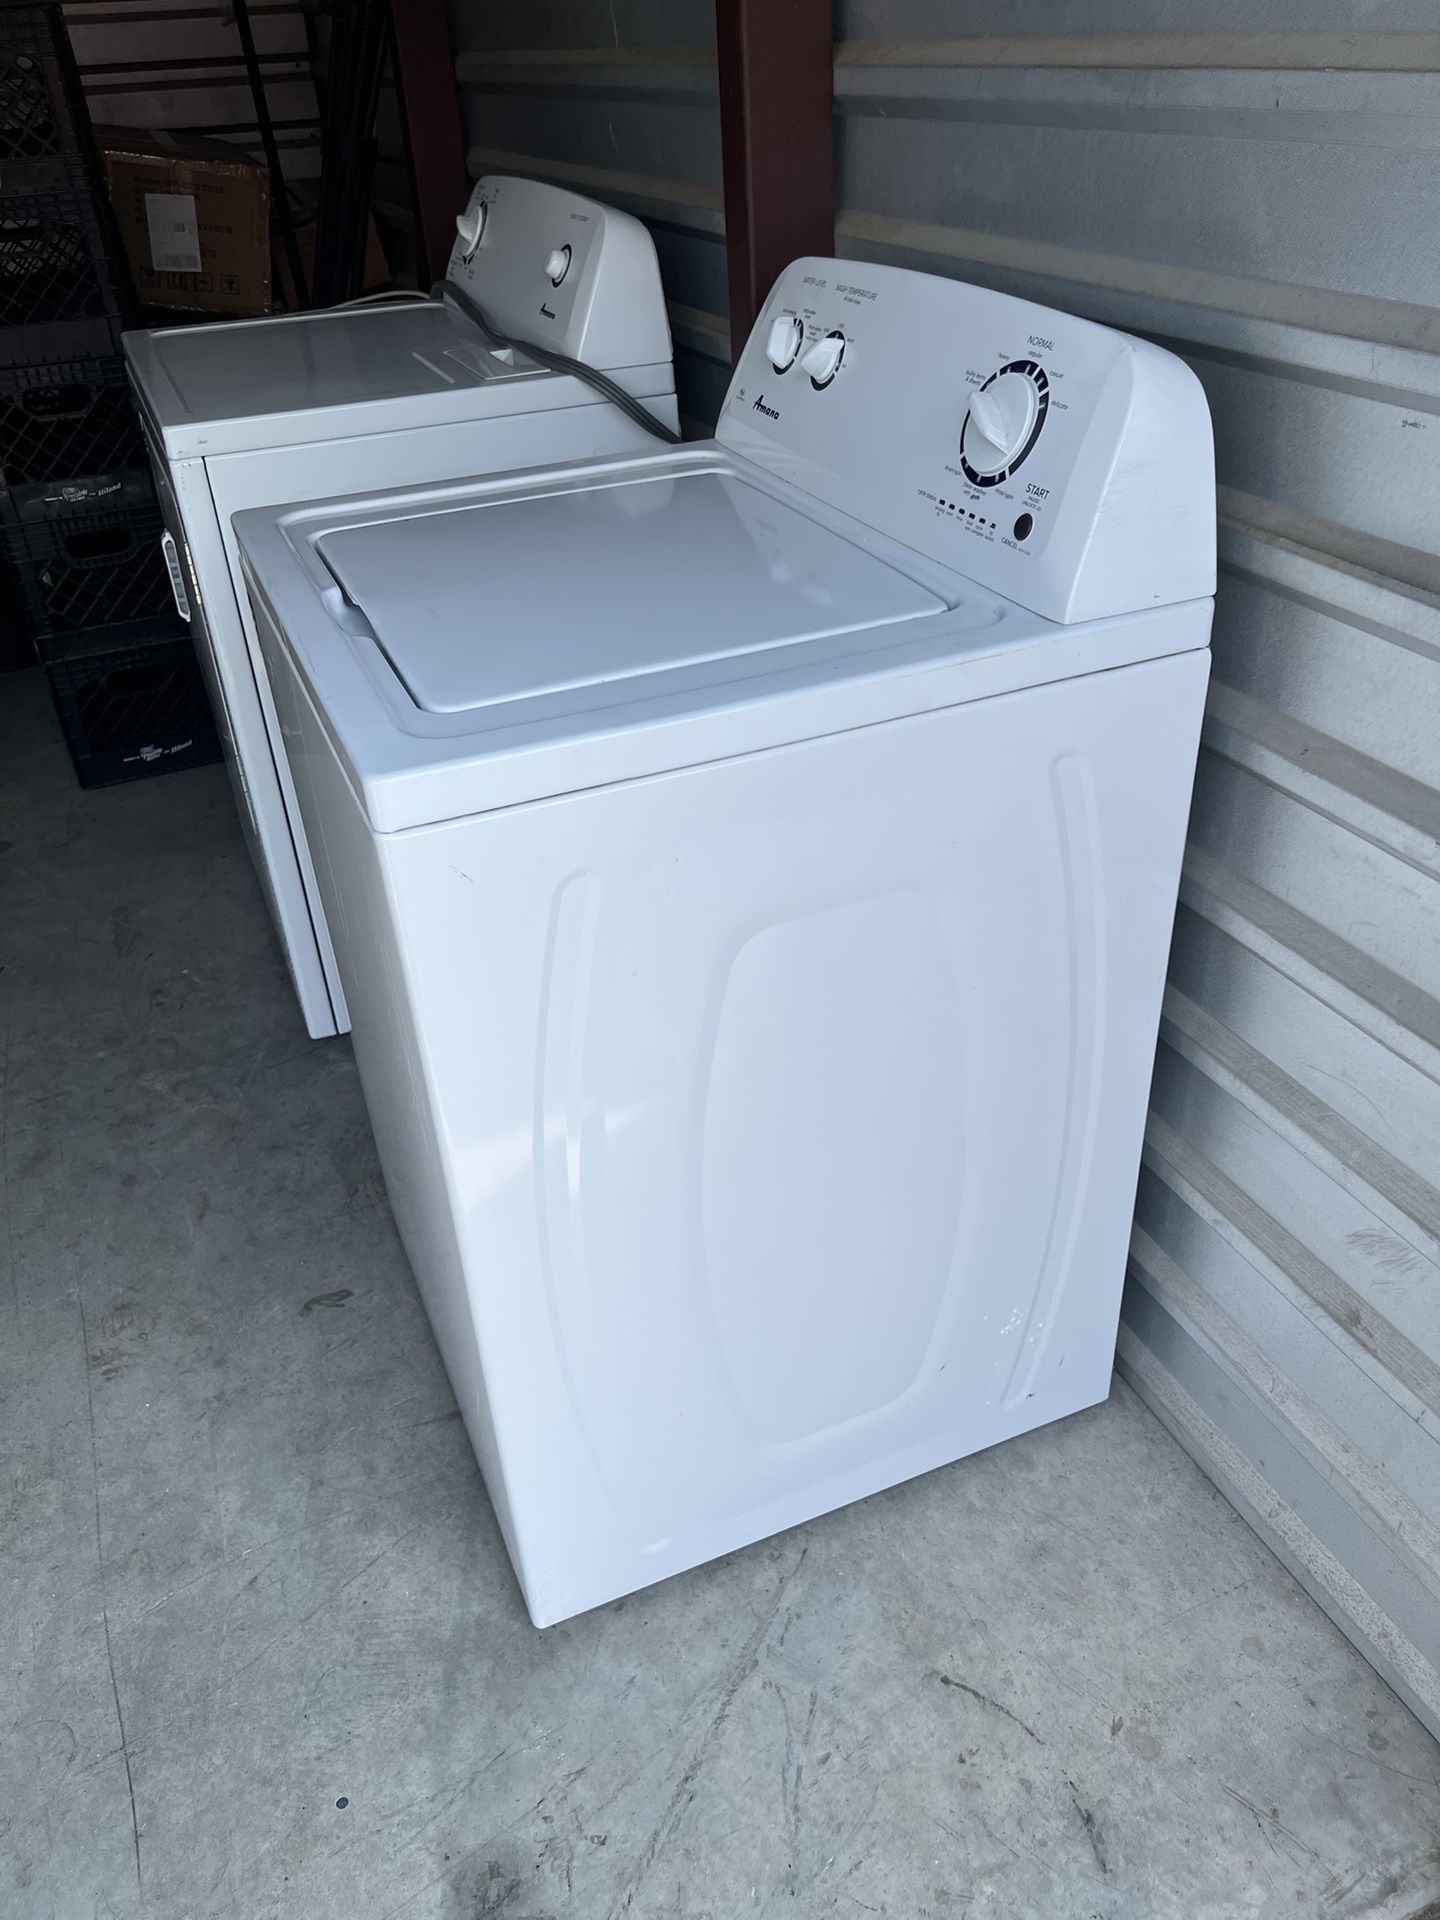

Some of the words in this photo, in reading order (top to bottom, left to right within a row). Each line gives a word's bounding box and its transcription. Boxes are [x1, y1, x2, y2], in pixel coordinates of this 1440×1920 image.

[848, 286, 879, 301] TEMPERATURE
[1027, 335, 1055, 351] NORMAL
[752, 394, 780, 420] Amana
[1026, 483, 1050, 500] START
[1001, 536, 1018, 550] CANCEL
